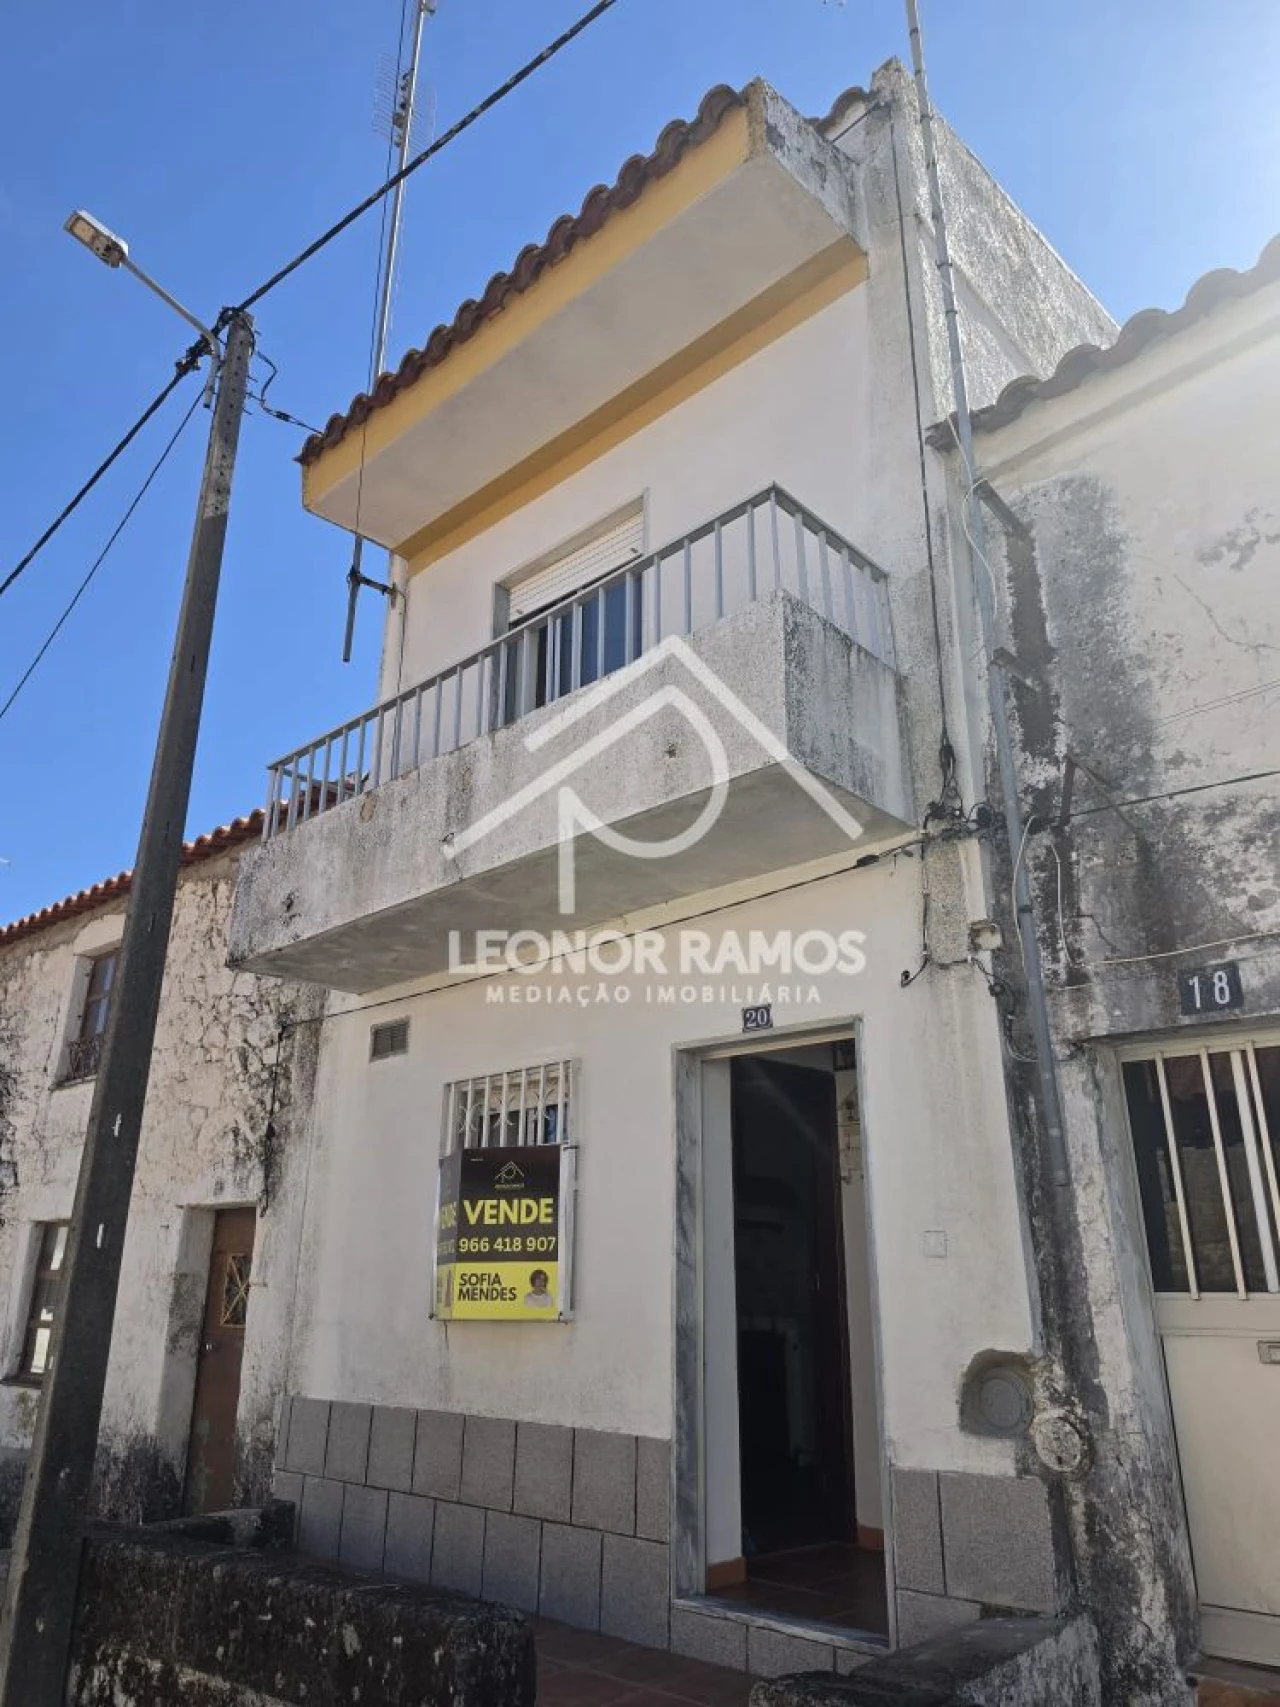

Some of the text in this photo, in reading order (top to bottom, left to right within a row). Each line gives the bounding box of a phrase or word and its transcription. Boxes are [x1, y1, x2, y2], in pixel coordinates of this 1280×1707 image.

[1188, 970, 1230, 1009] 18
[745, 1008, 767, 1027] 20
[463, 1199, 554, 1225] VENDE
[459, 1237, 489, 1252] 966
[493, 1236, 521, 1251] 418
[526, 1236, 556, 1251] 907
[459, 1273, 502, 1286] SOFIA
[457, 1287, 517, 1301] MENDES
